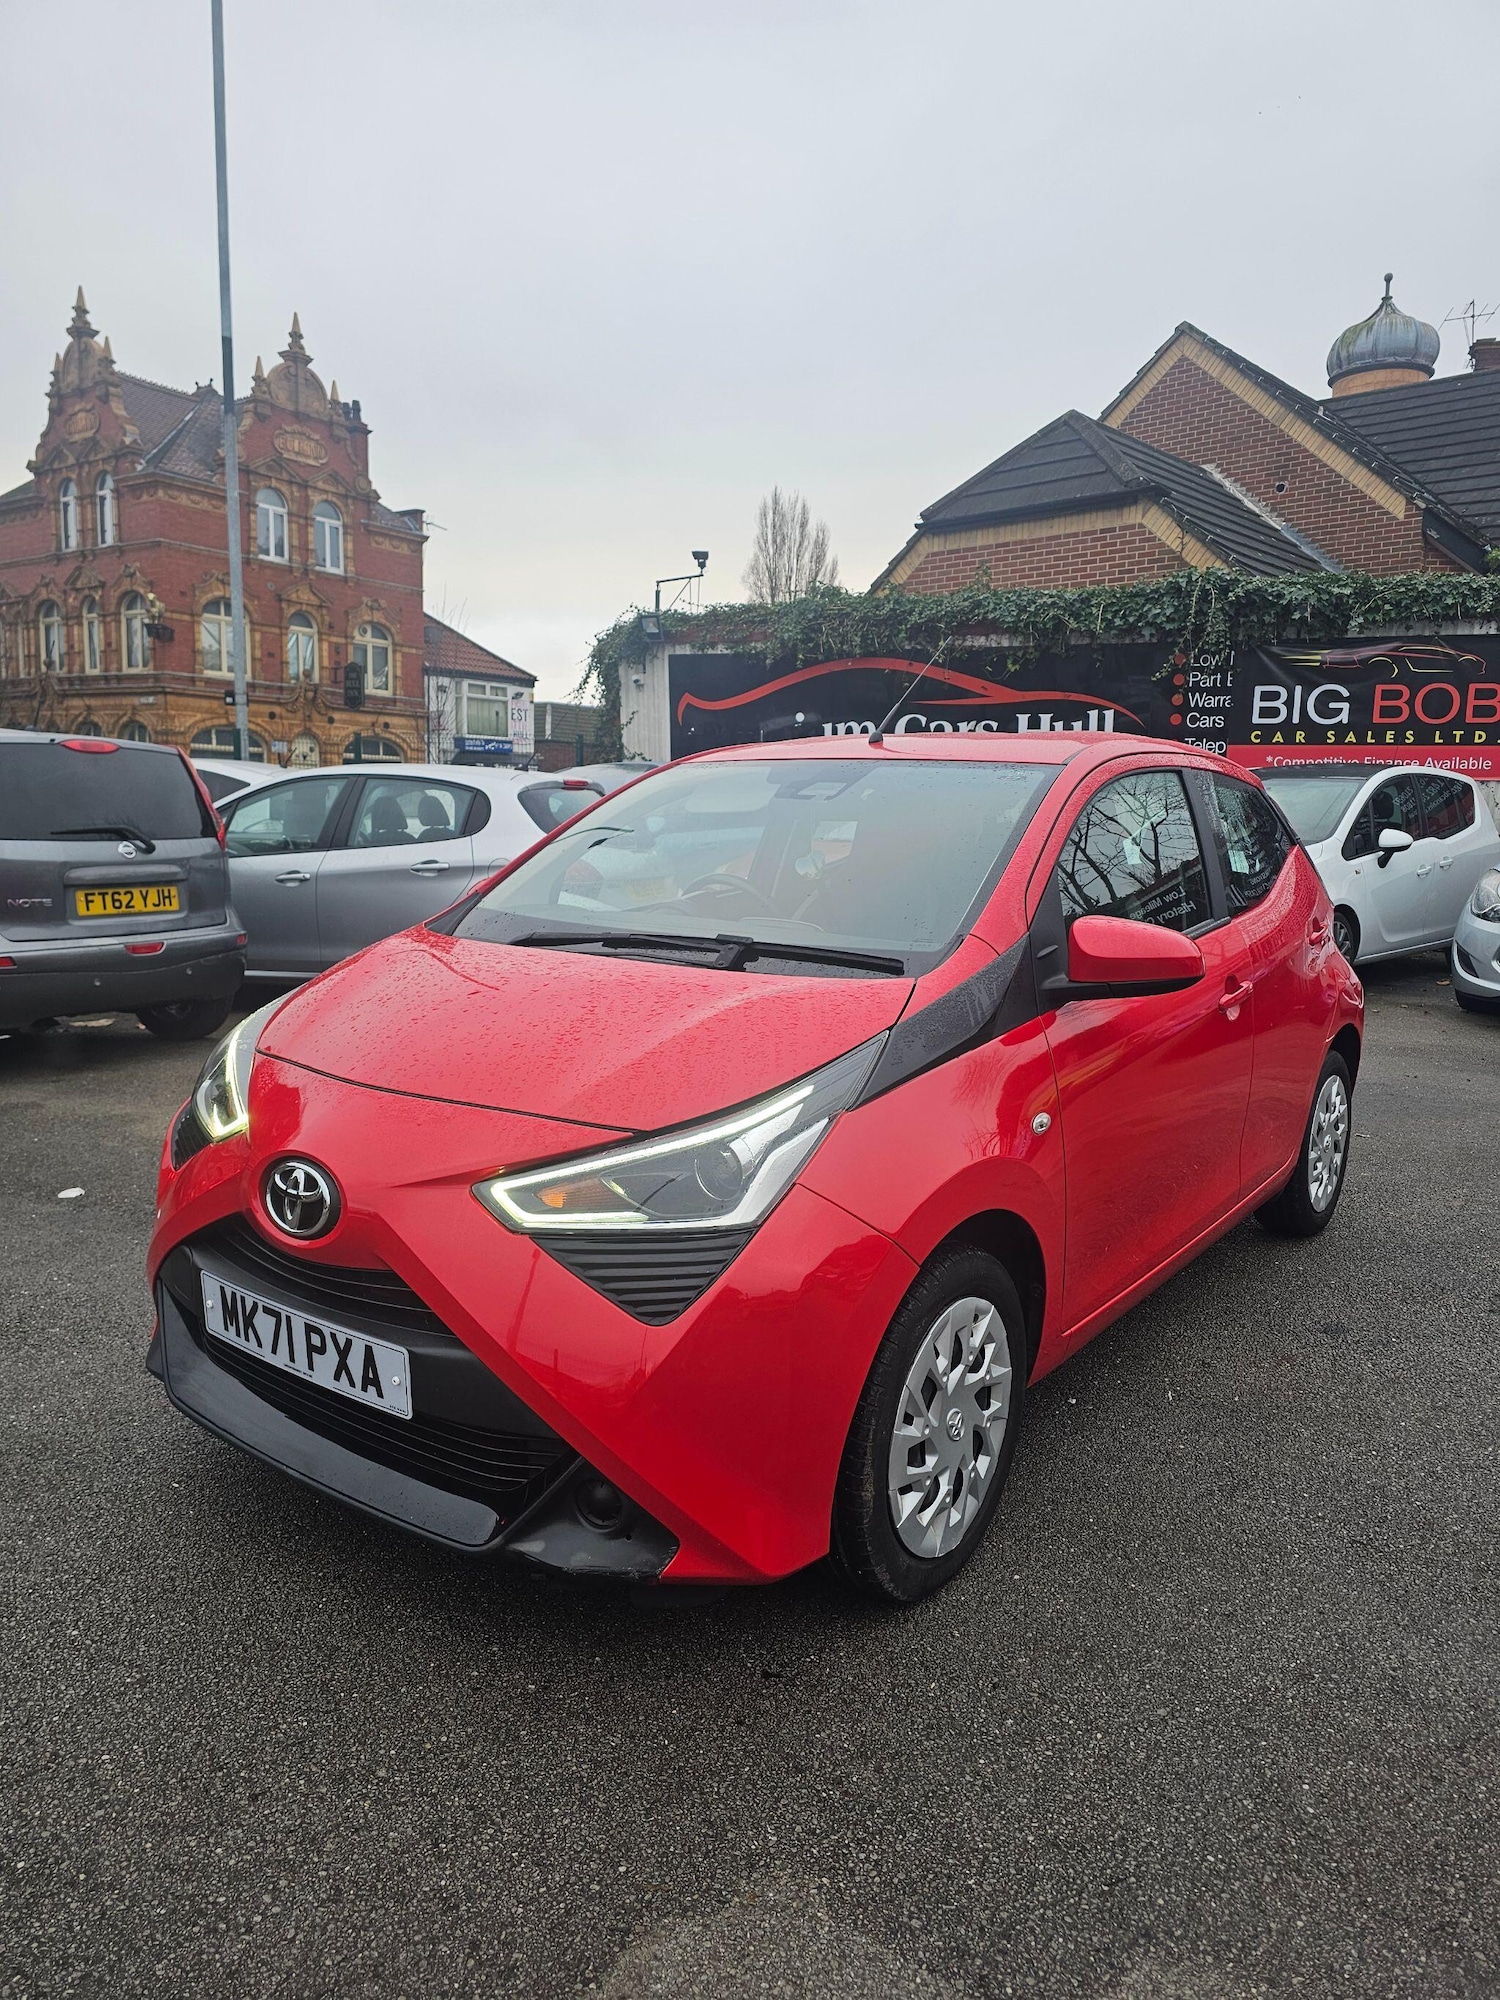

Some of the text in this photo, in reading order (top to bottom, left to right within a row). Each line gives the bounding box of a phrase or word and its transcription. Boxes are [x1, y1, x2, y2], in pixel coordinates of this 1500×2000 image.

[1189, 671, 1222, 687] Part
[1251, 682, 1500, 725] BIG BOB
[1186, 712, 1225, 728] Cars
[1250, 730, 1306, 743] CAR
[1326, 730, 1415, 743] SALES
[1424, 756, 1492, 770] Available
[7, 898, 53, 908] NOTE
[84, 888, 173, 912] FT62 YJH
[219, 1284, 385, 1400] MK71 PXA
